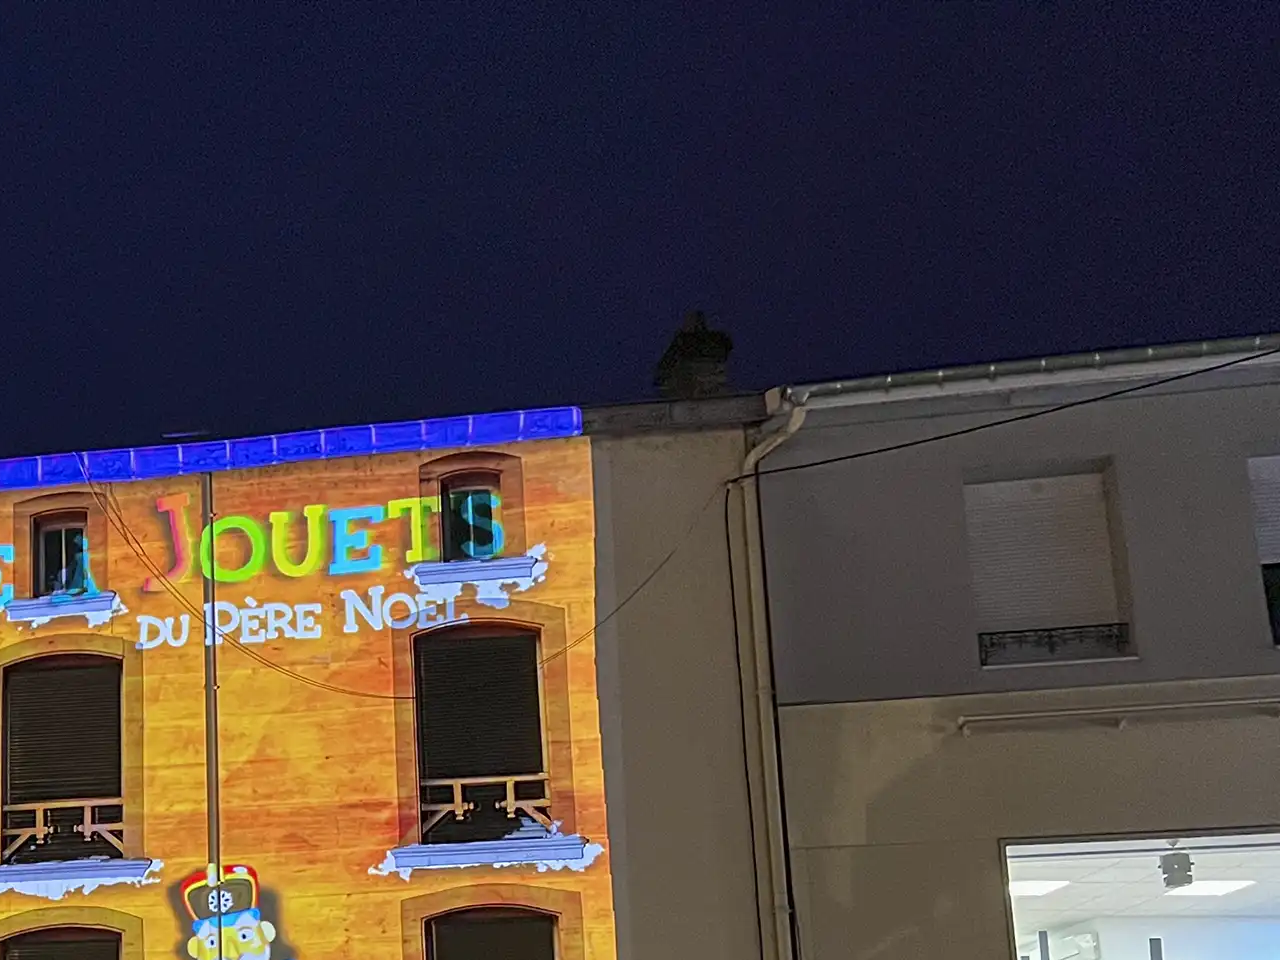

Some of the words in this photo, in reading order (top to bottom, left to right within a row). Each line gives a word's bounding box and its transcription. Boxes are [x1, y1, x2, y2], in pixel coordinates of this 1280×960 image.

[143, 491, 505, 592] JOUETS
[135, 614, 190, 650] DU
[204, 596, 322, 646] PÈRE
